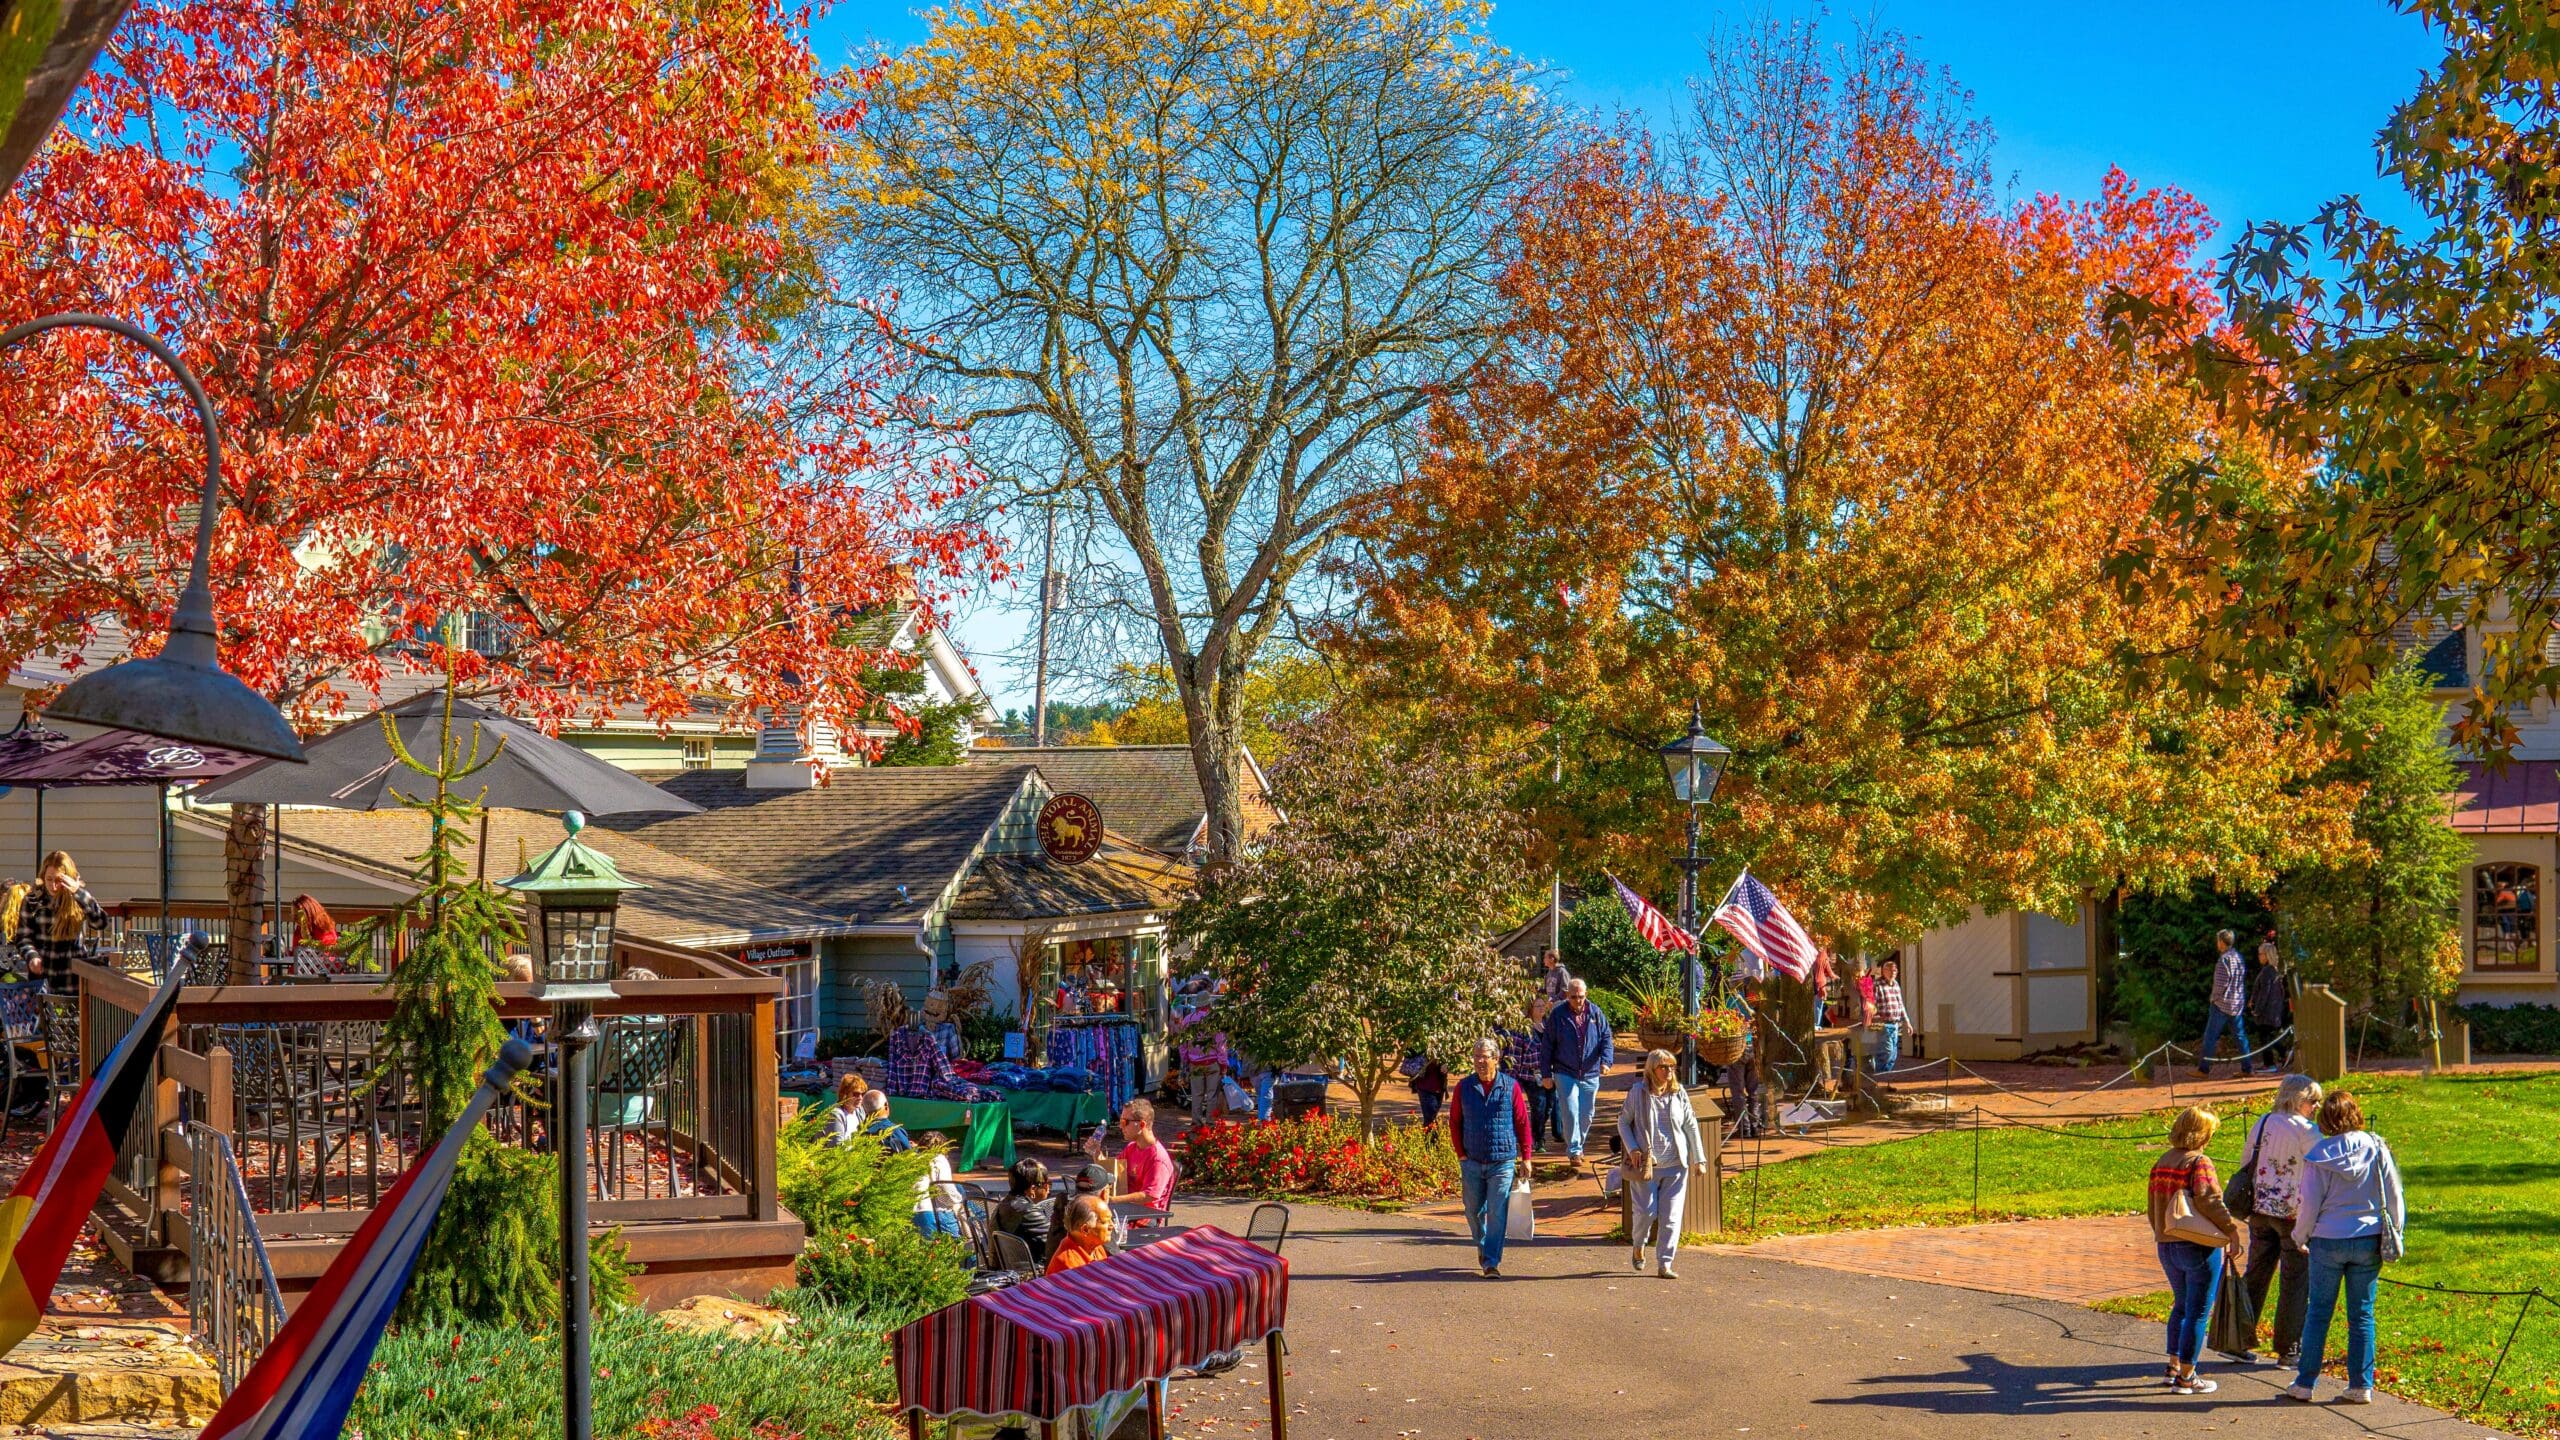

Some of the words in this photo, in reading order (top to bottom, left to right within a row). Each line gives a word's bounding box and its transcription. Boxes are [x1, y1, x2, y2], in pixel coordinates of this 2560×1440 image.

[1044, 798, 1077, 818] TOTAL
[1041, 822, 1051, 847] THE
[1079, 803, 1098, 849] ANIMAL
[746, 949, 766, 961] Village
[767, 946, 795, 957] Outfitters
